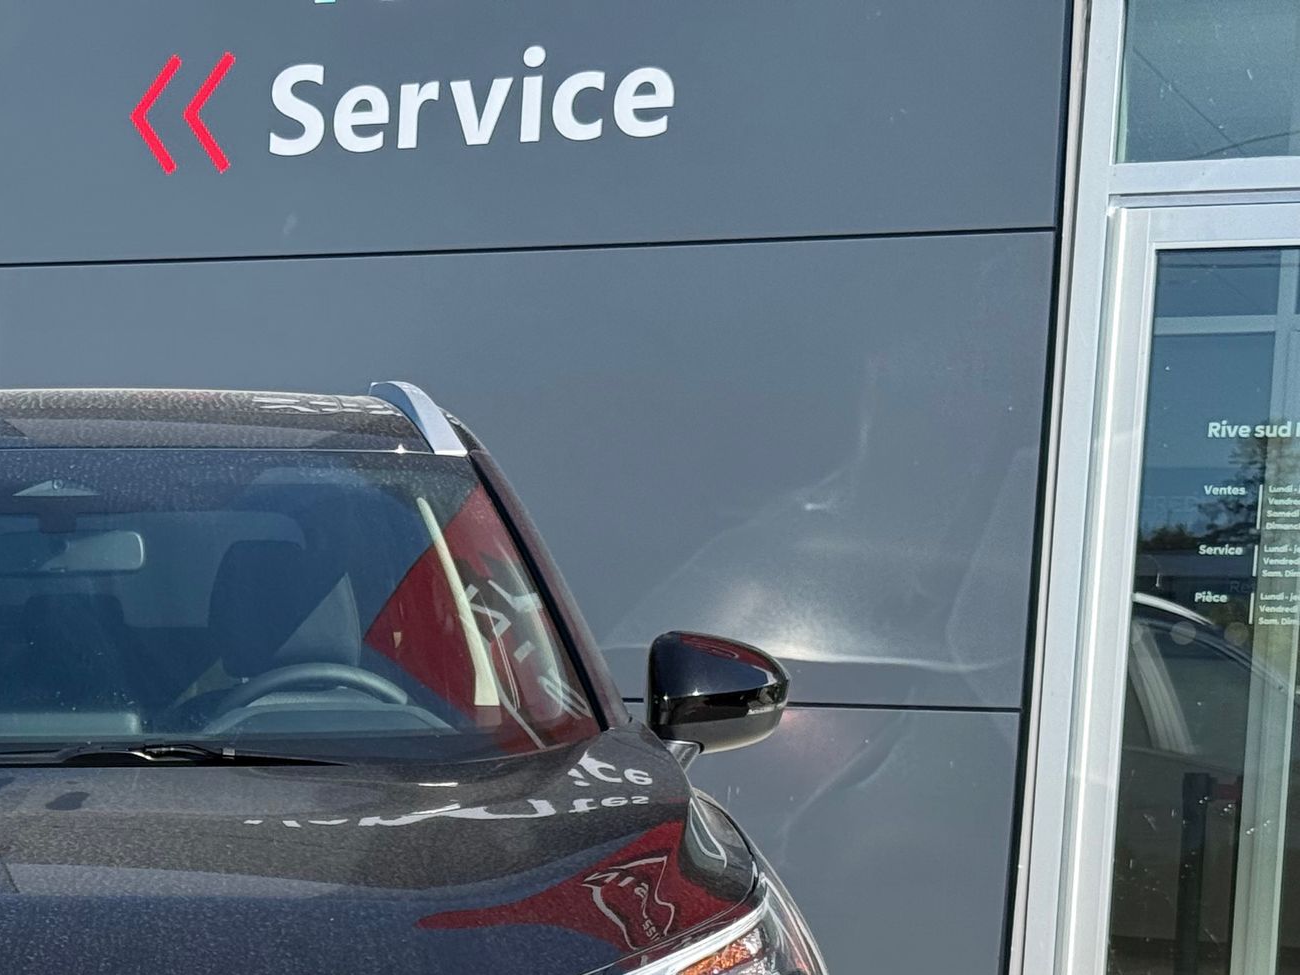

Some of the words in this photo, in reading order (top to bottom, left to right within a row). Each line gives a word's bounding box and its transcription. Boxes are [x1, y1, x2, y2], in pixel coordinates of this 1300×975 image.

[269, 45, 676, 156] Service
[1207, 420, 1252, 438] Rive
[1253, 420, 1292, 438] sud
[1203, 484, 1247, 496] Ventes
[1198, 543, 1244, 556] Service
[1194, 590, 1228, 603] Pièce
